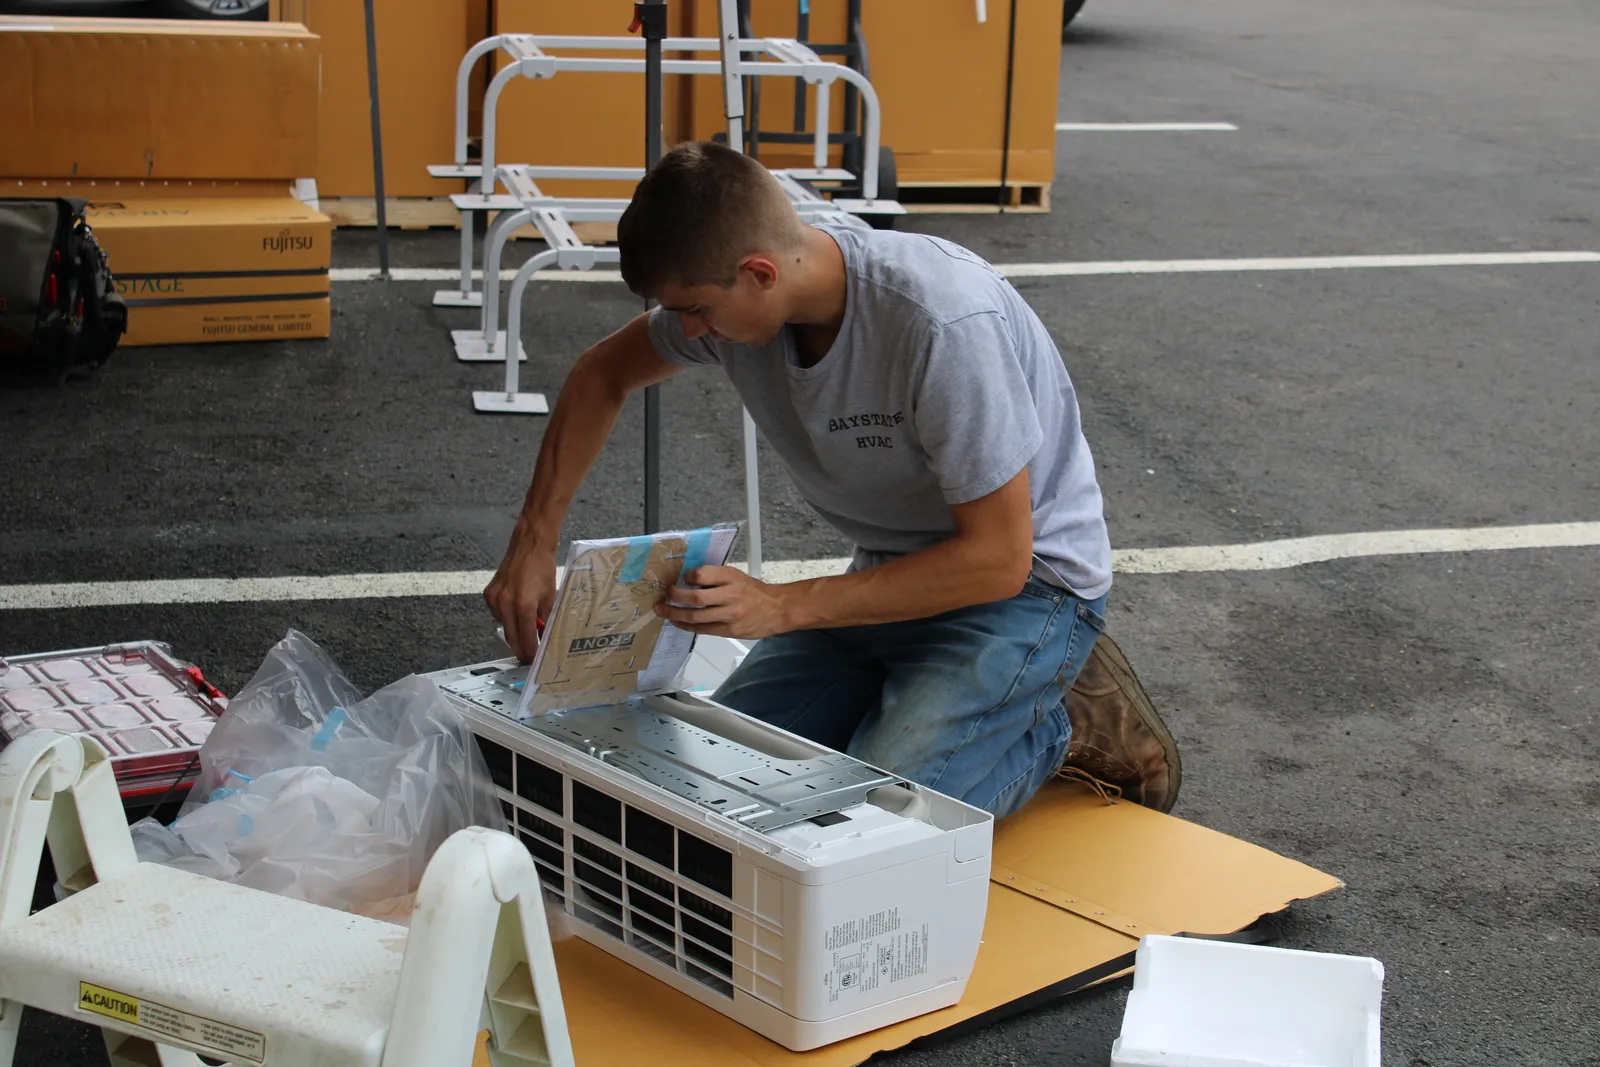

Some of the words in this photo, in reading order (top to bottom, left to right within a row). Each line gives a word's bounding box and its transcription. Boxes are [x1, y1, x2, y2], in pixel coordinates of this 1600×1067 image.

[262, 229, 313, 254] FUJITSU
[202, 324, 235, 336] FUJITSU
[238, 323, 274, 334] GENERAL
[278, 322, 312, 332] LIMITED
[829, 411, 905, 432] BAYSTATE
[856, 435, 894, 449] HVAC
[571, 633, 633, 651] FRONT
[93, 993, 138, 1016] CAUTION
